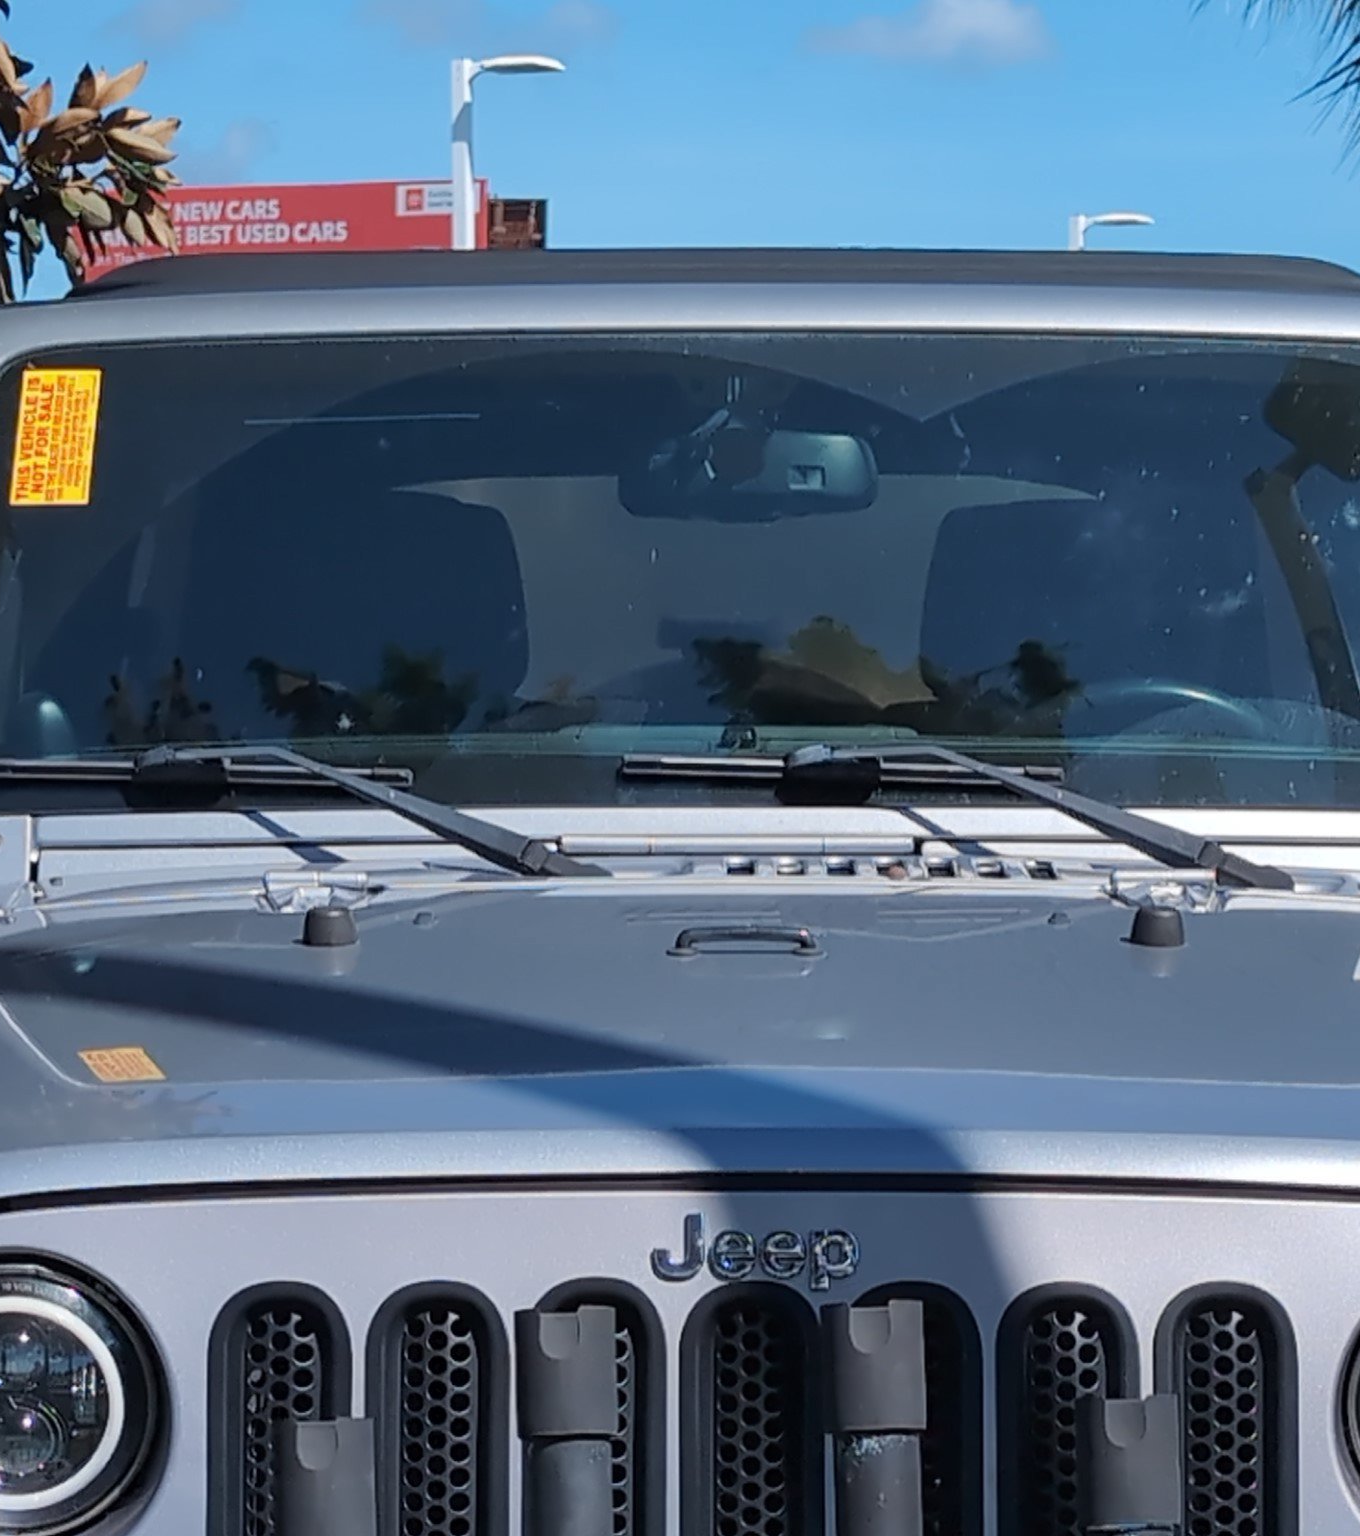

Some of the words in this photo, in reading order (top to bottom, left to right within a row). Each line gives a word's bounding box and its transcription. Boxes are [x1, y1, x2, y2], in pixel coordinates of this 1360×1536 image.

[174, 201, 223, 222] NEW
[226, 199, 280, 220] CARS
[185, 225, 232, 245] BEST
[235, 223, 290, 244] USED
[293, 221, 348, 242] CARS
[26, 377, 40, 392] IS
[38, 384, 54, 422] SALE
[19, 396, 39, 461] VEHICLE
[34, 427, 50, 457] FOR
[14, 466, 31, 501] THIS
[31, 462, 46, 494] NOT
[650, 1211, 860, 1291] Jeep
